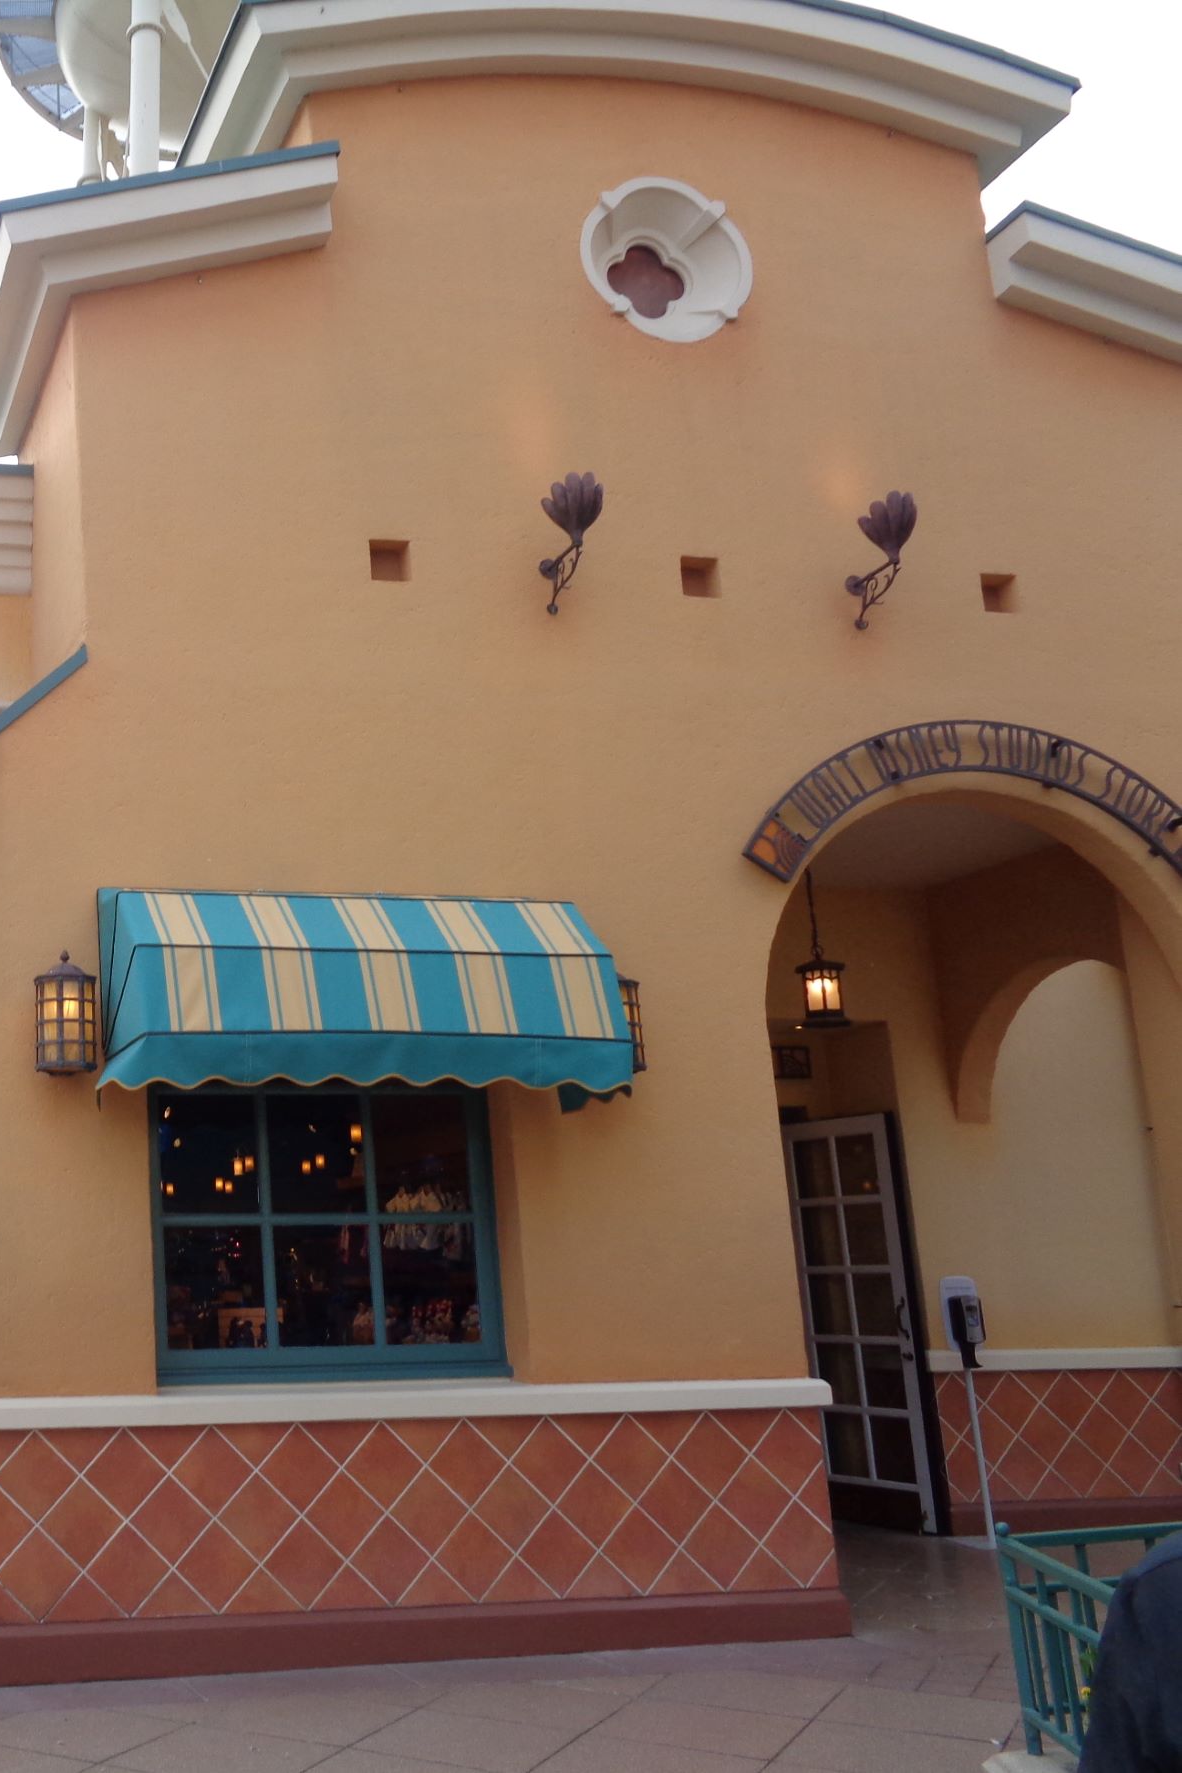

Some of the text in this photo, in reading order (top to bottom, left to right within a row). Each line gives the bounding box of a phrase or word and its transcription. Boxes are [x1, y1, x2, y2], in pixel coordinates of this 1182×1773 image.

[792, 725, 1177, 838] WALT DISNEY STUDIOS STORE
